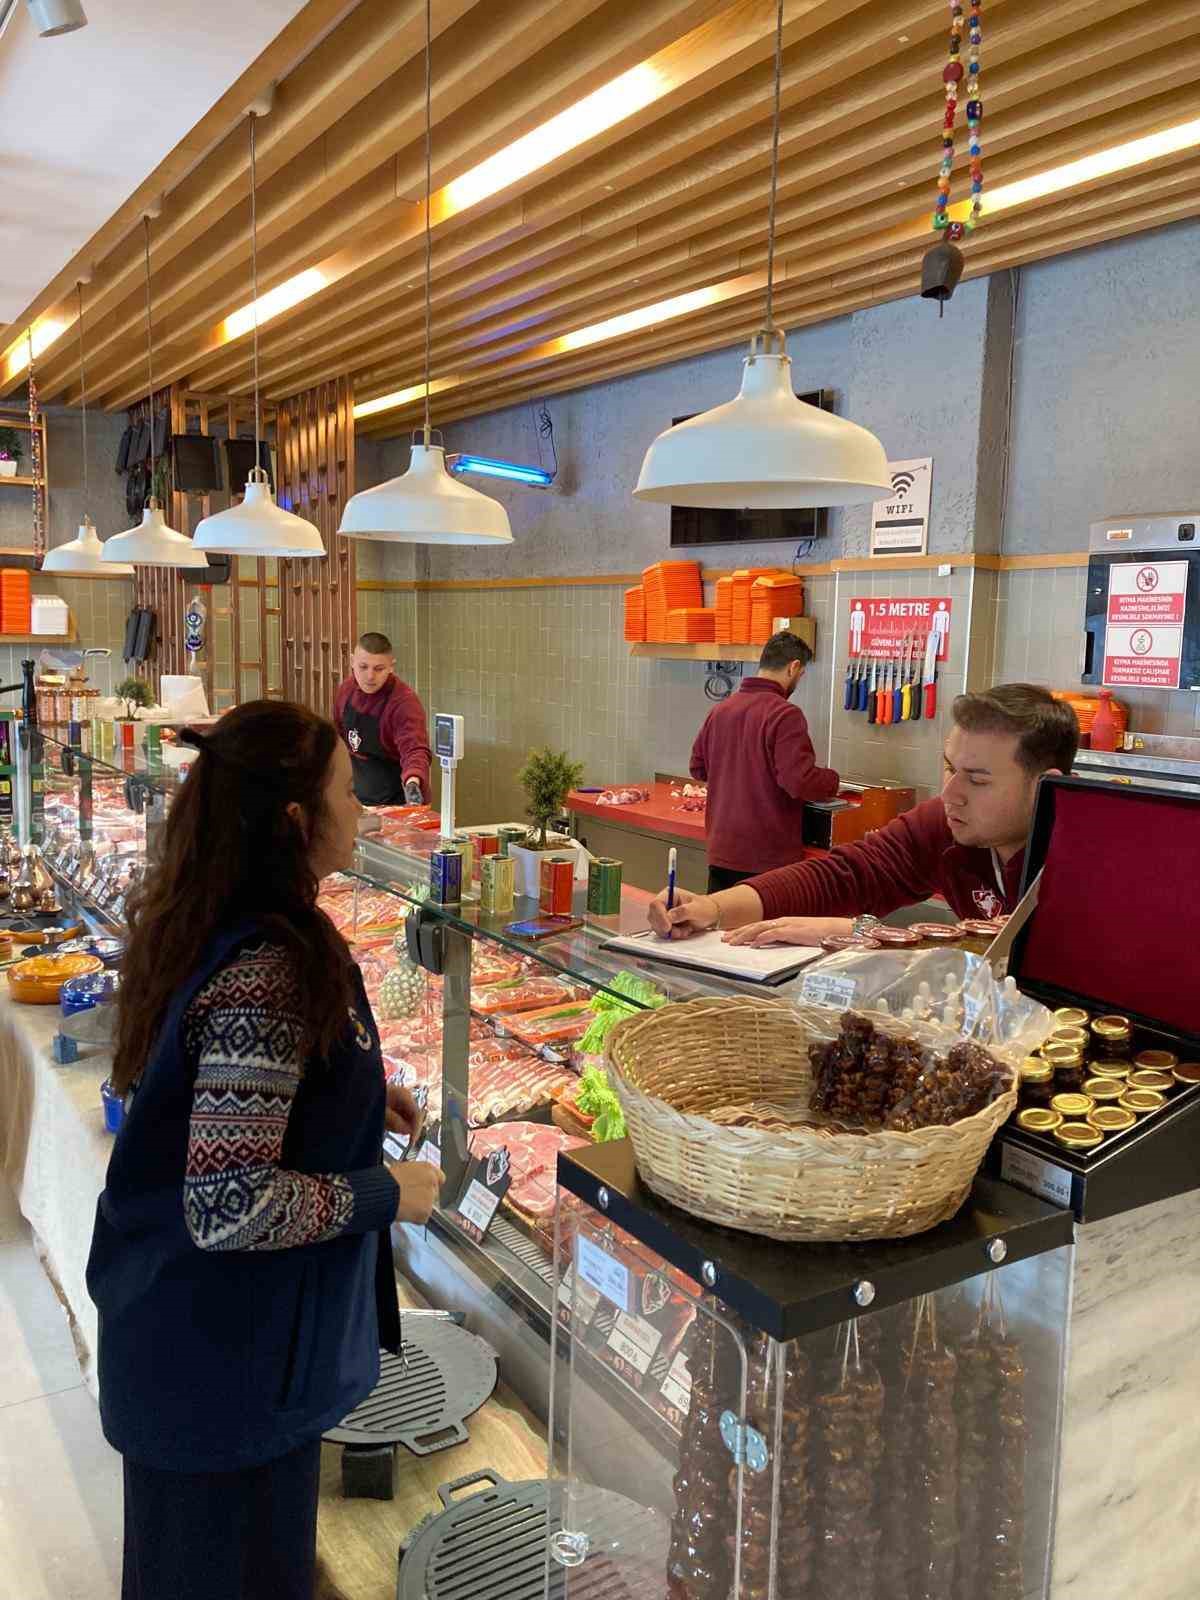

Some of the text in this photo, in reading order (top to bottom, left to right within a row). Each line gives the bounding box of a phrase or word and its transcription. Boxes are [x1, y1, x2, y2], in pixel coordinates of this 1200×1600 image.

[886, 504, 914, 515] WIFI
[869, 603, 931, 617] 1.5 METRE
